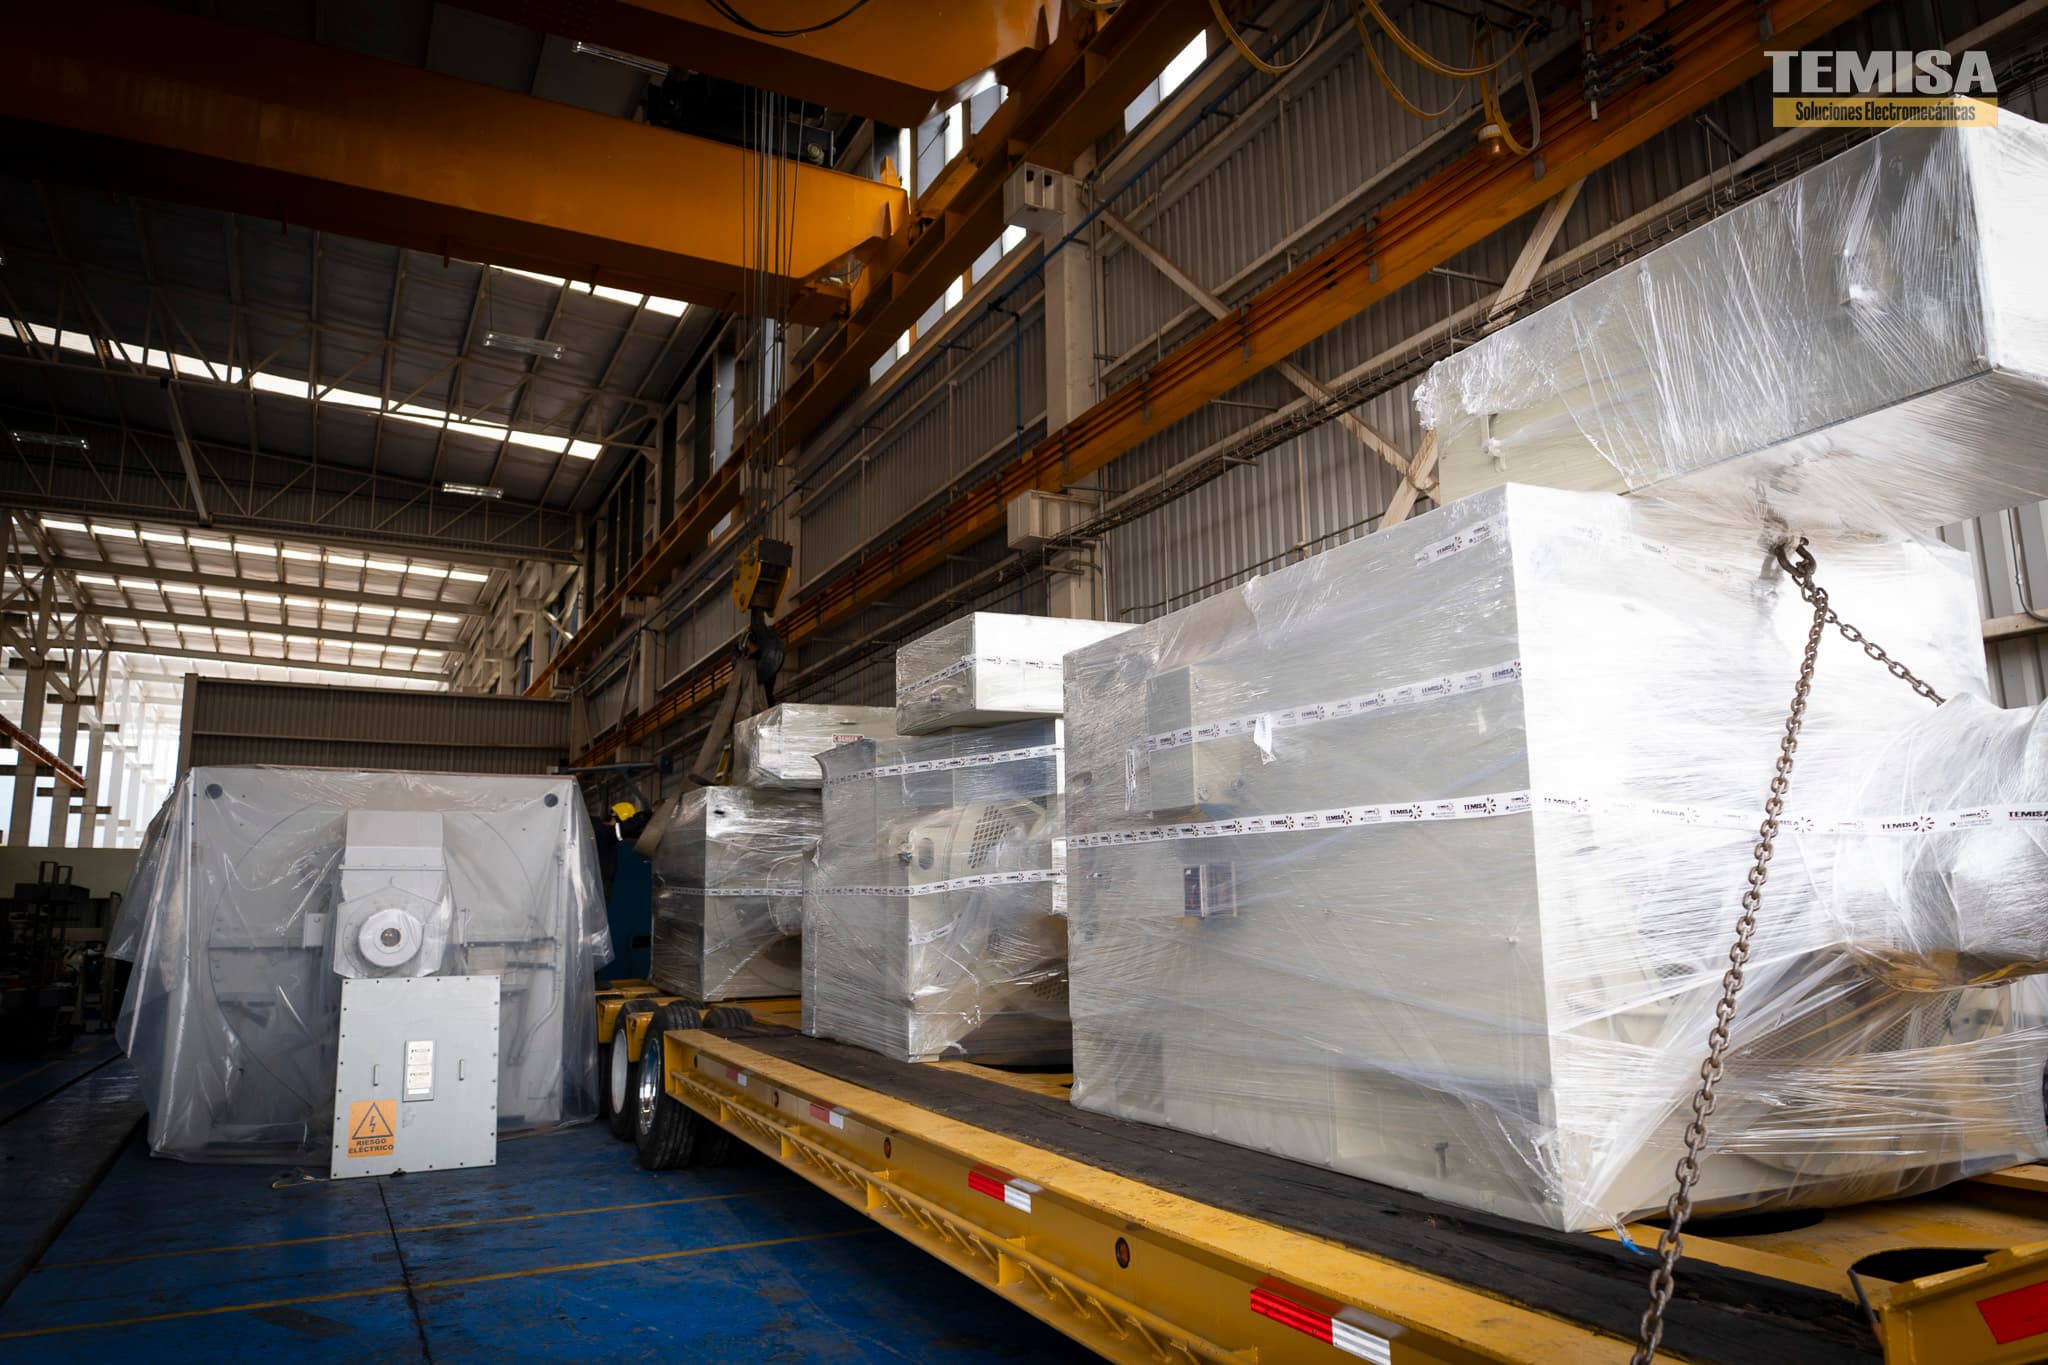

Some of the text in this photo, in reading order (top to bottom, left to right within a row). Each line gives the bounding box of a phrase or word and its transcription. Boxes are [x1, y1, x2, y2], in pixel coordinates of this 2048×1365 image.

[1390, 808, 1413, 816] TEMISA
[1881, 821, 1919, 830] TEMISA
[356, 1138, 387, 1146] RIESGO
